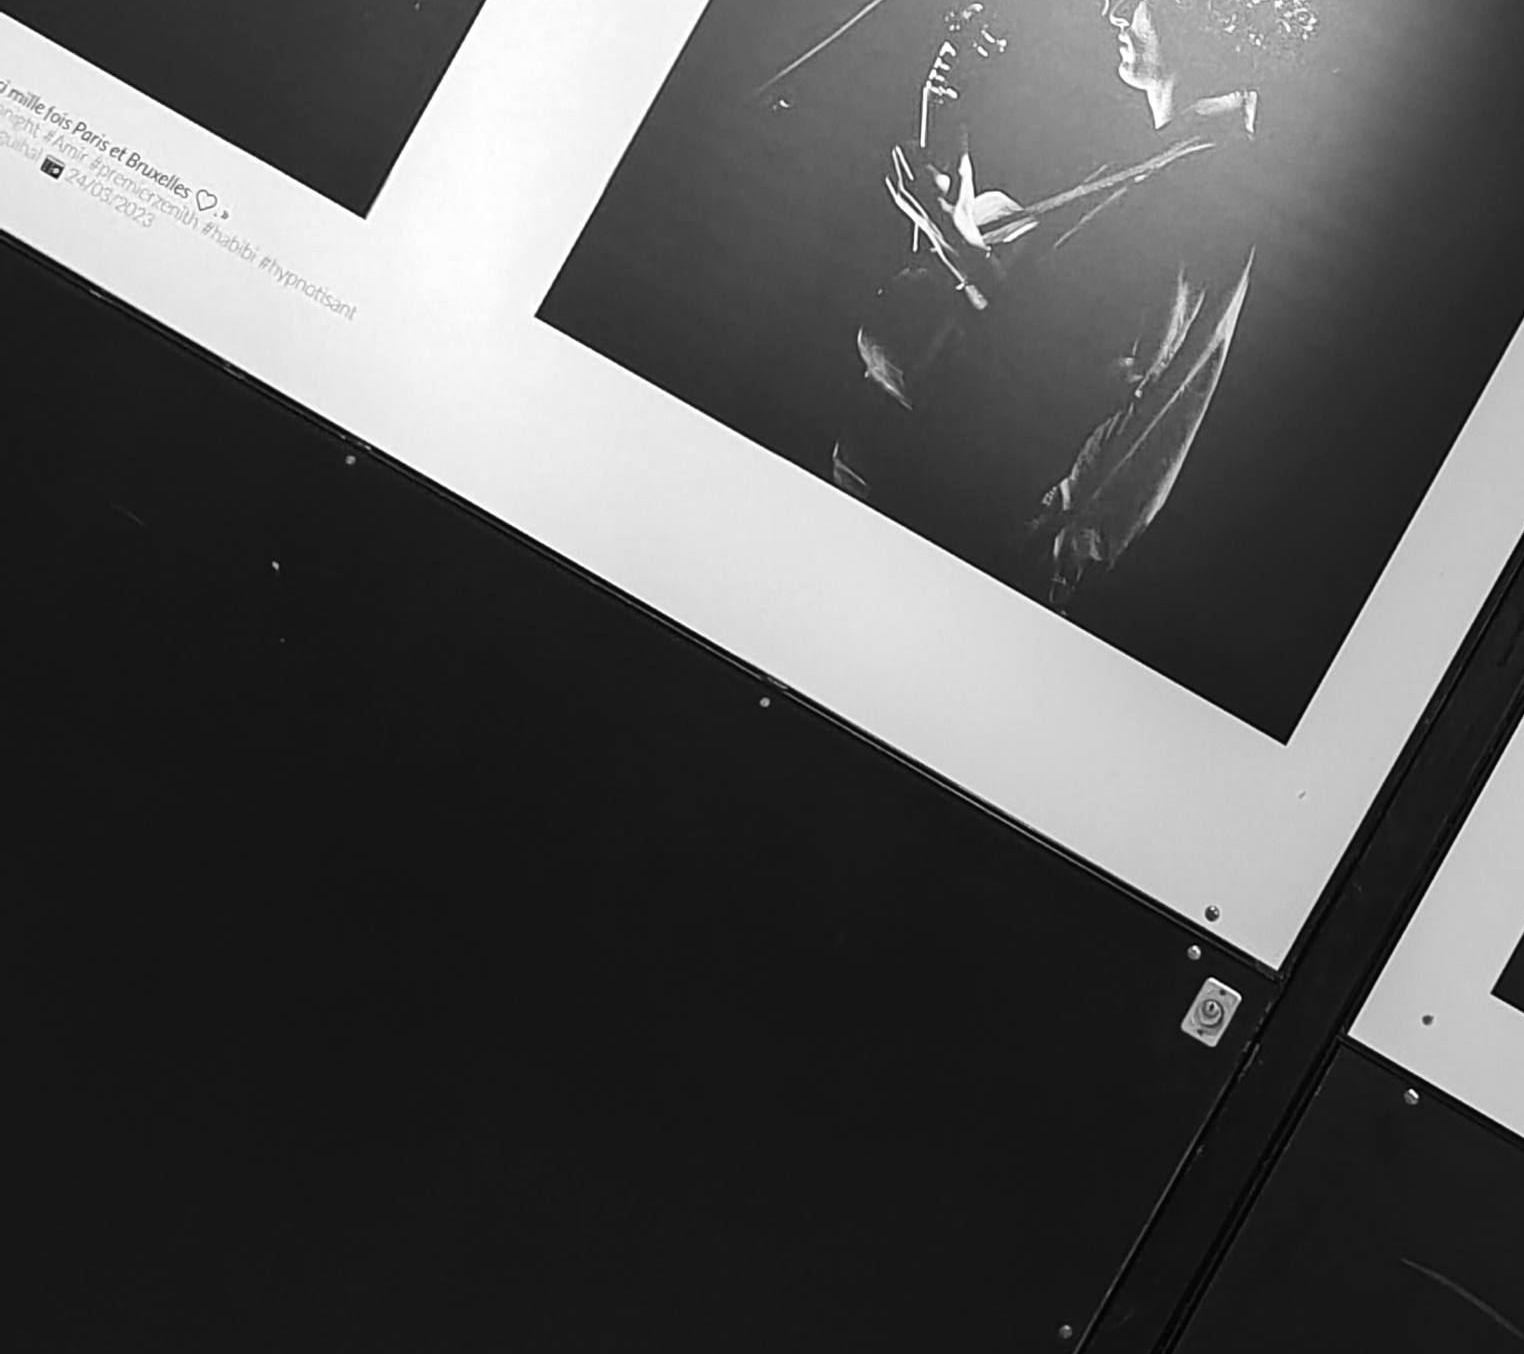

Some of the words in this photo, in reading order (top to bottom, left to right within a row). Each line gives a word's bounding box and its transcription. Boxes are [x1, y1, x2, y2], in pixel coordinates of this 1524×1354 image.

[7, 88, 46, 115] mille
[42, 105, 73, 130] fois
[71, 121, 110, 152] Paris
[109, 146, 128, 162] et
[125, 152, 192, 199] Bruxelles
[43, 129, 88, 162] #Amir
[201, 221, 258, 263] #habibi
[258, 255, 358, 321] #hypnotisant
